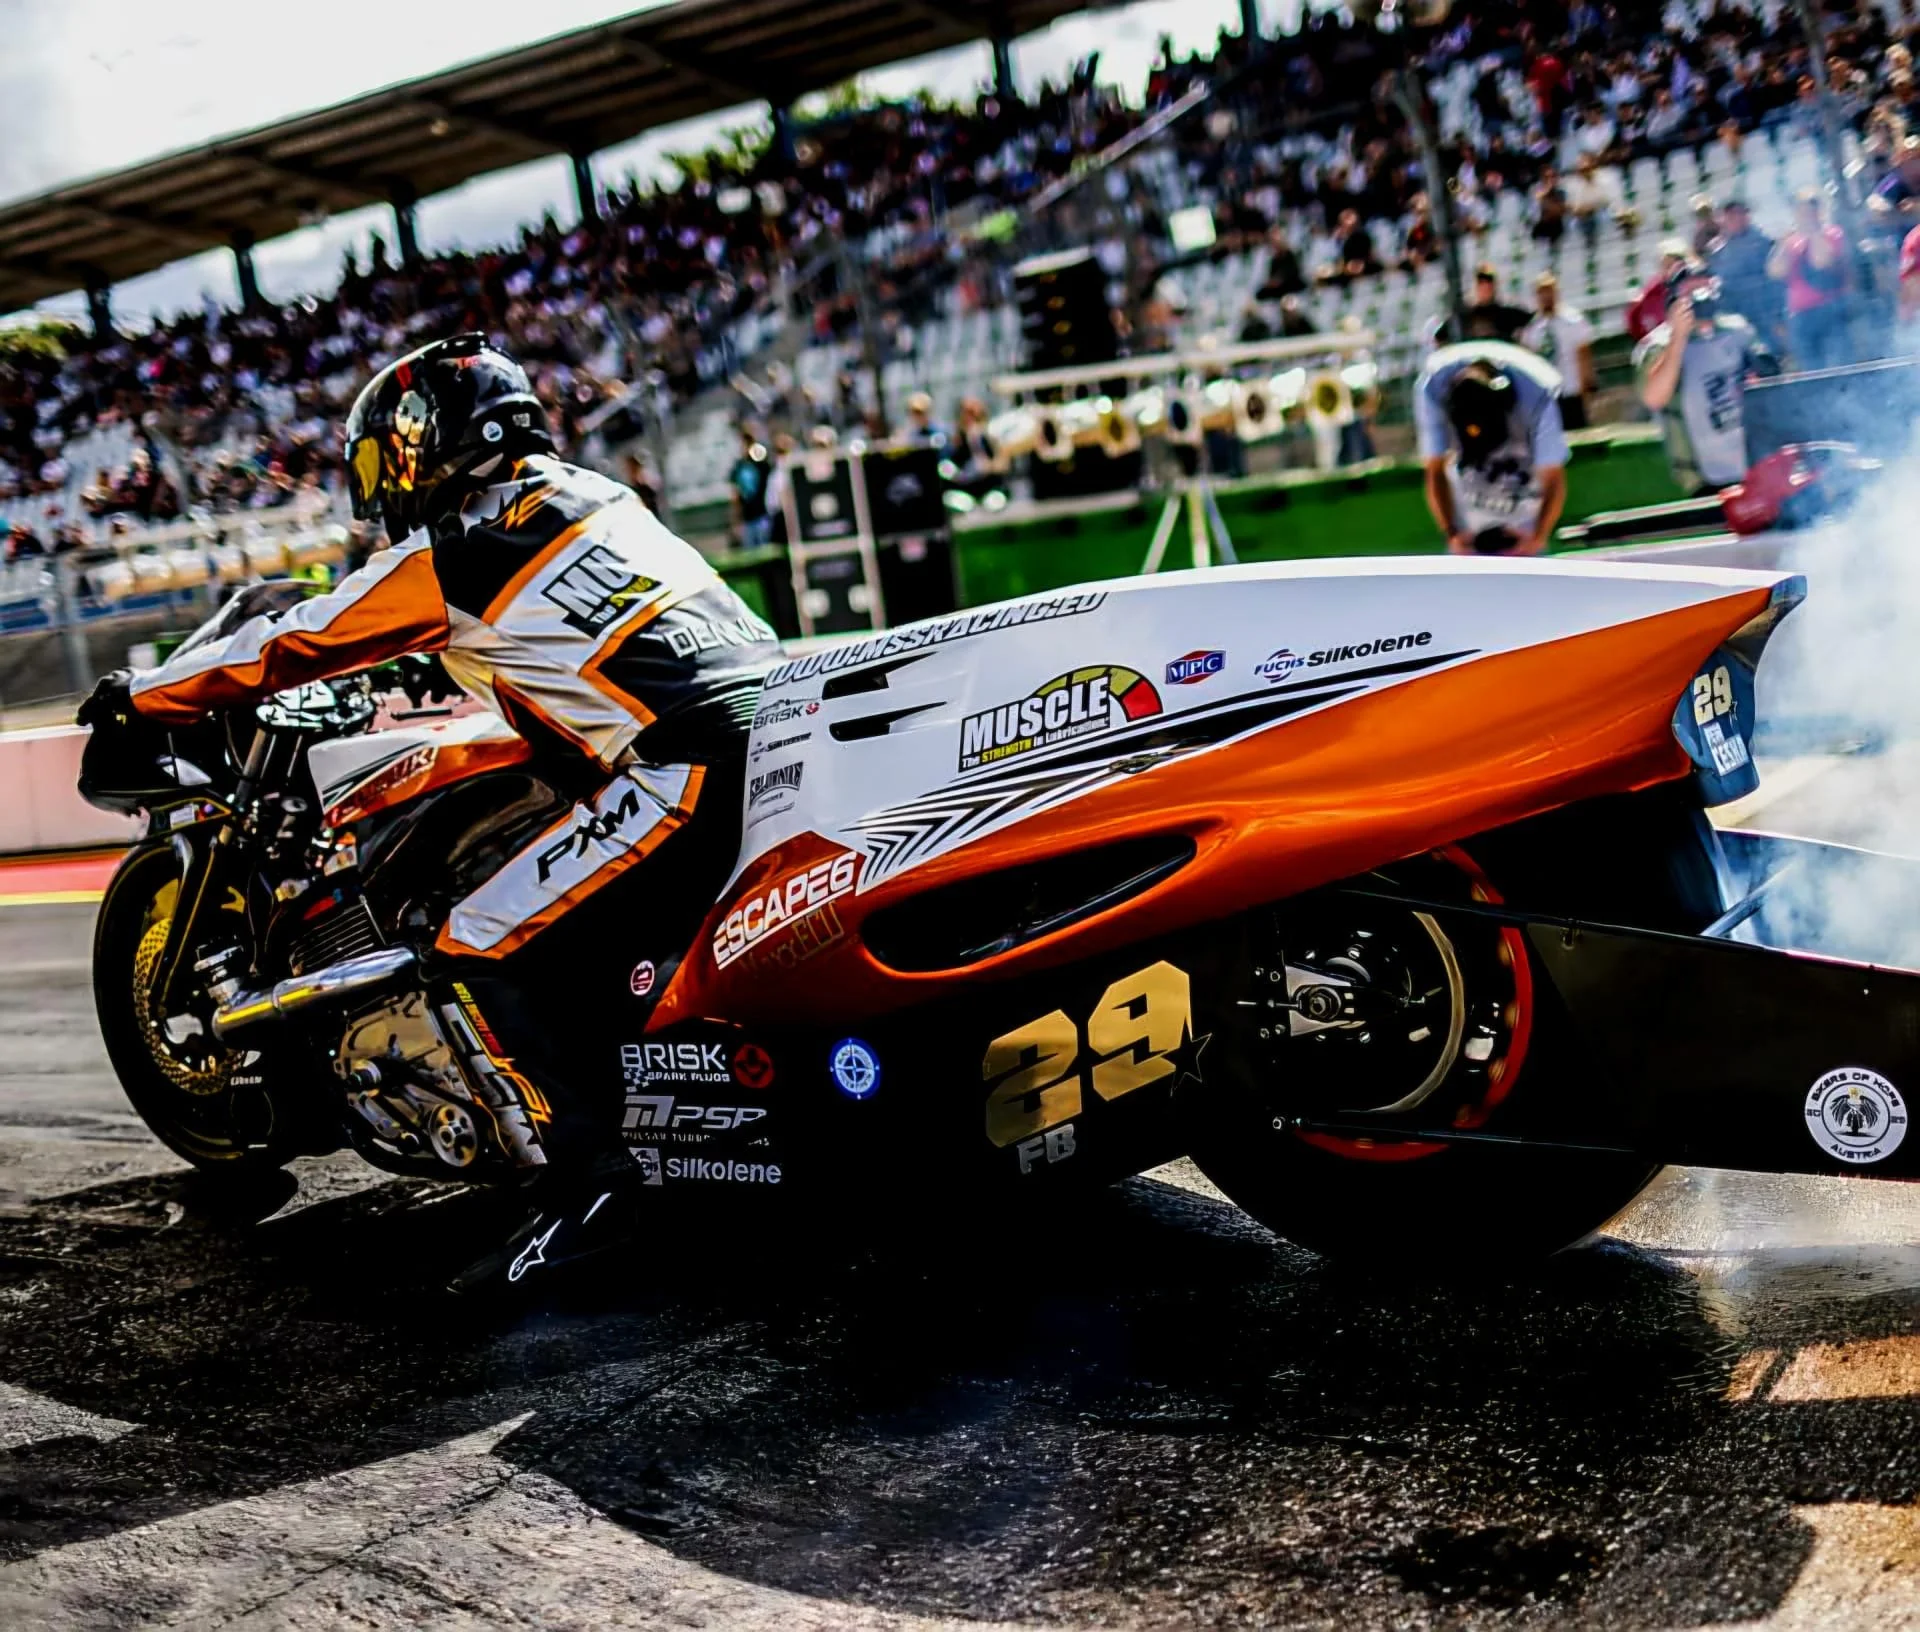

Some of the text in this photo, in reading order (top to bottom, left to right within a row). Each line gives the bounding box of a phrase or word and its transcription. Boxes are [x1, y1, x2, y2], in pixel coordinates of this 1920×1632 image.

[1167, 654, 1222, 684] MPC
[1306, 631, 1432, 668] Silkolene
[962, 675, 1109, 757] MUSCLE
[1693, 665, 1733, 727] 29
[536, 788, 640, 885] PXM
[712, 851, 857, 966] ESCAPE6
[620, 1043, 726, 1071] BRISK
[982, 959, 1193, 1148] 29
[671, 1105, 768, 1130] PSP
[666, 1157, 783, 1184] Silkolene
[1016, 1123, 1077, 1175] FB
